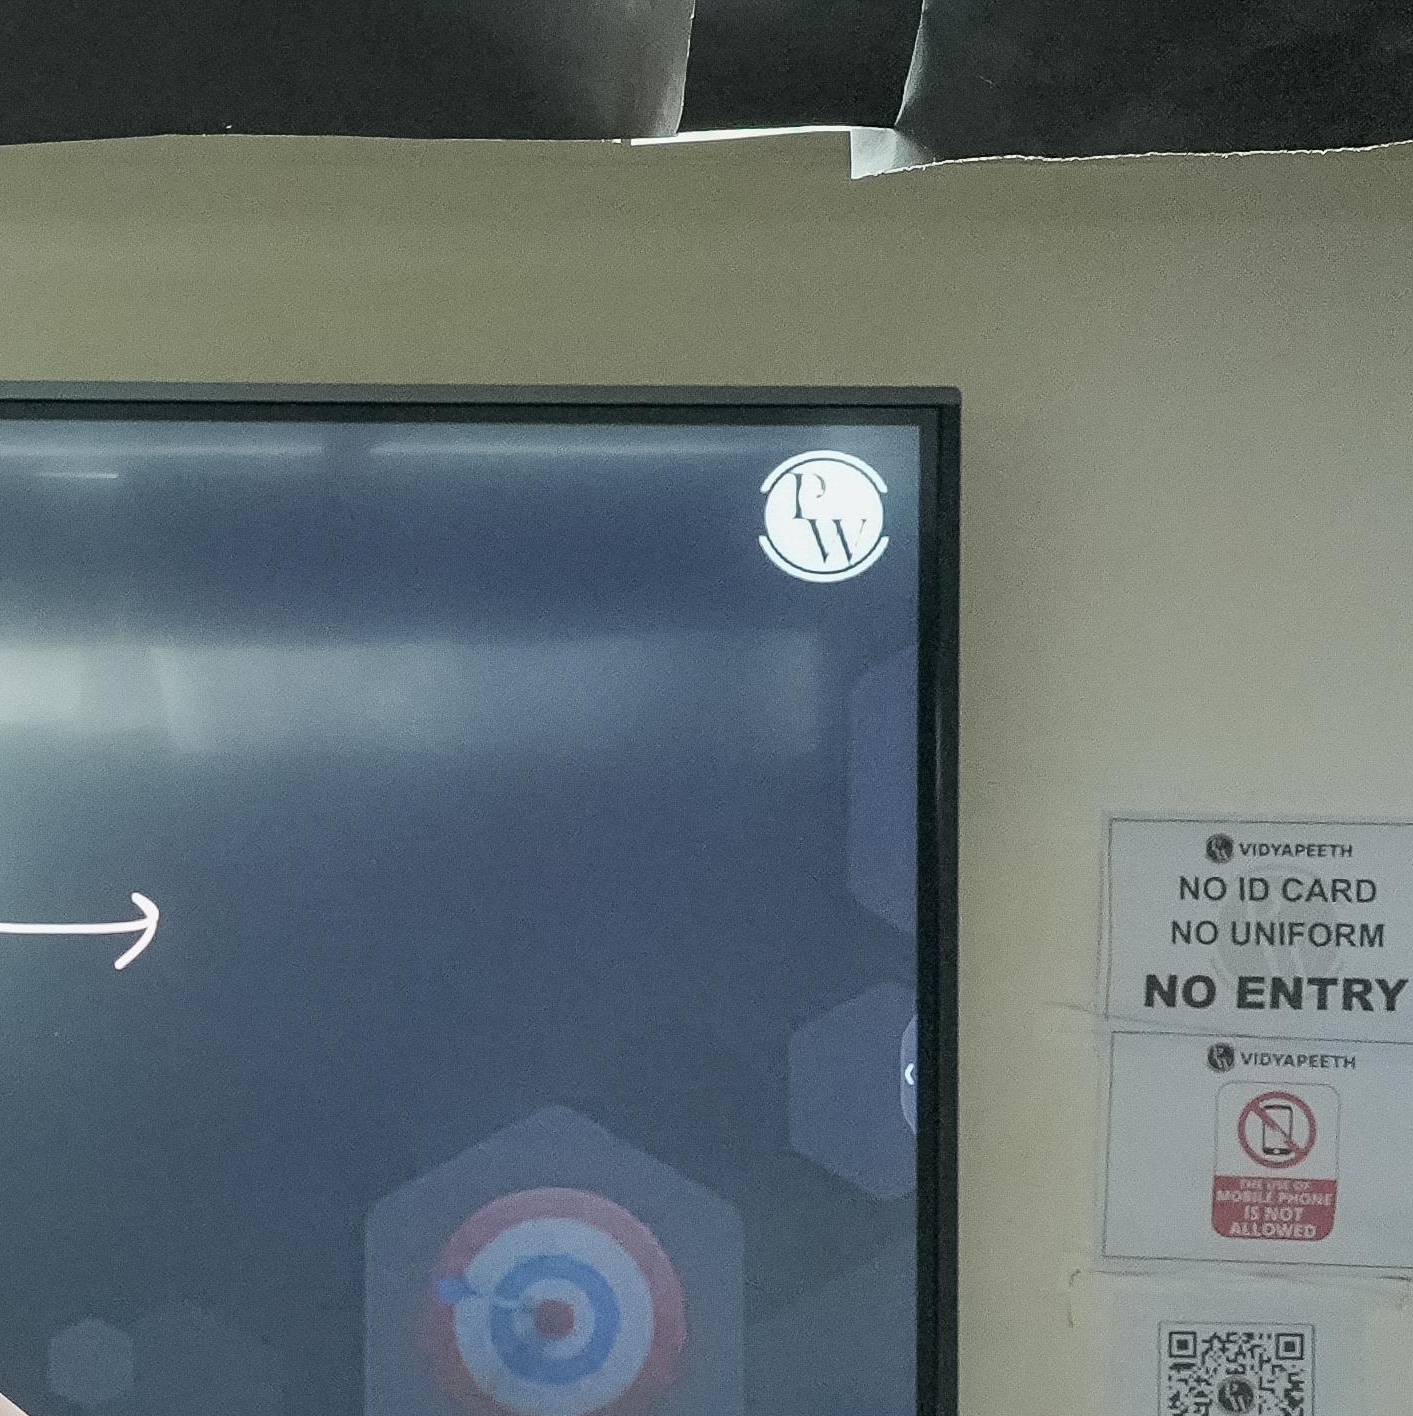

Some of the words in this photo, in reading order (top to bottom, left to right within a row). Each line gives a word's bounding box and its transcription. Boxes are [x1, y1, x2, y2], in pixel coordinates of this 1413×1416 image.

[1238, 843, 1353, 857] VIDYAPEETH
[1179, 876, 1227, 901] NO
[1240, 876, 1269, 902] ID
[1281, 877, 1377, 903] CARD
[1171, 920, 1218, 945] NO
[1231, 921, 1385, 948] UNIFORM
[1144, 974, 1217, 1009] NO
[1236, 976, 1410, 1012] ENTRY
[1240, 1052, 1357, 1069] VIDYAPEETH
[1216, 1190, 1274, 1202] MOBILE
[1278, 1191, 1334, 1206] PHONE
[1244, 1205, 1260, 1220] IS
[1264, 1206, 1303, 1221] NOT
[1229, 1221, 1317, 1237] ALLOWED
